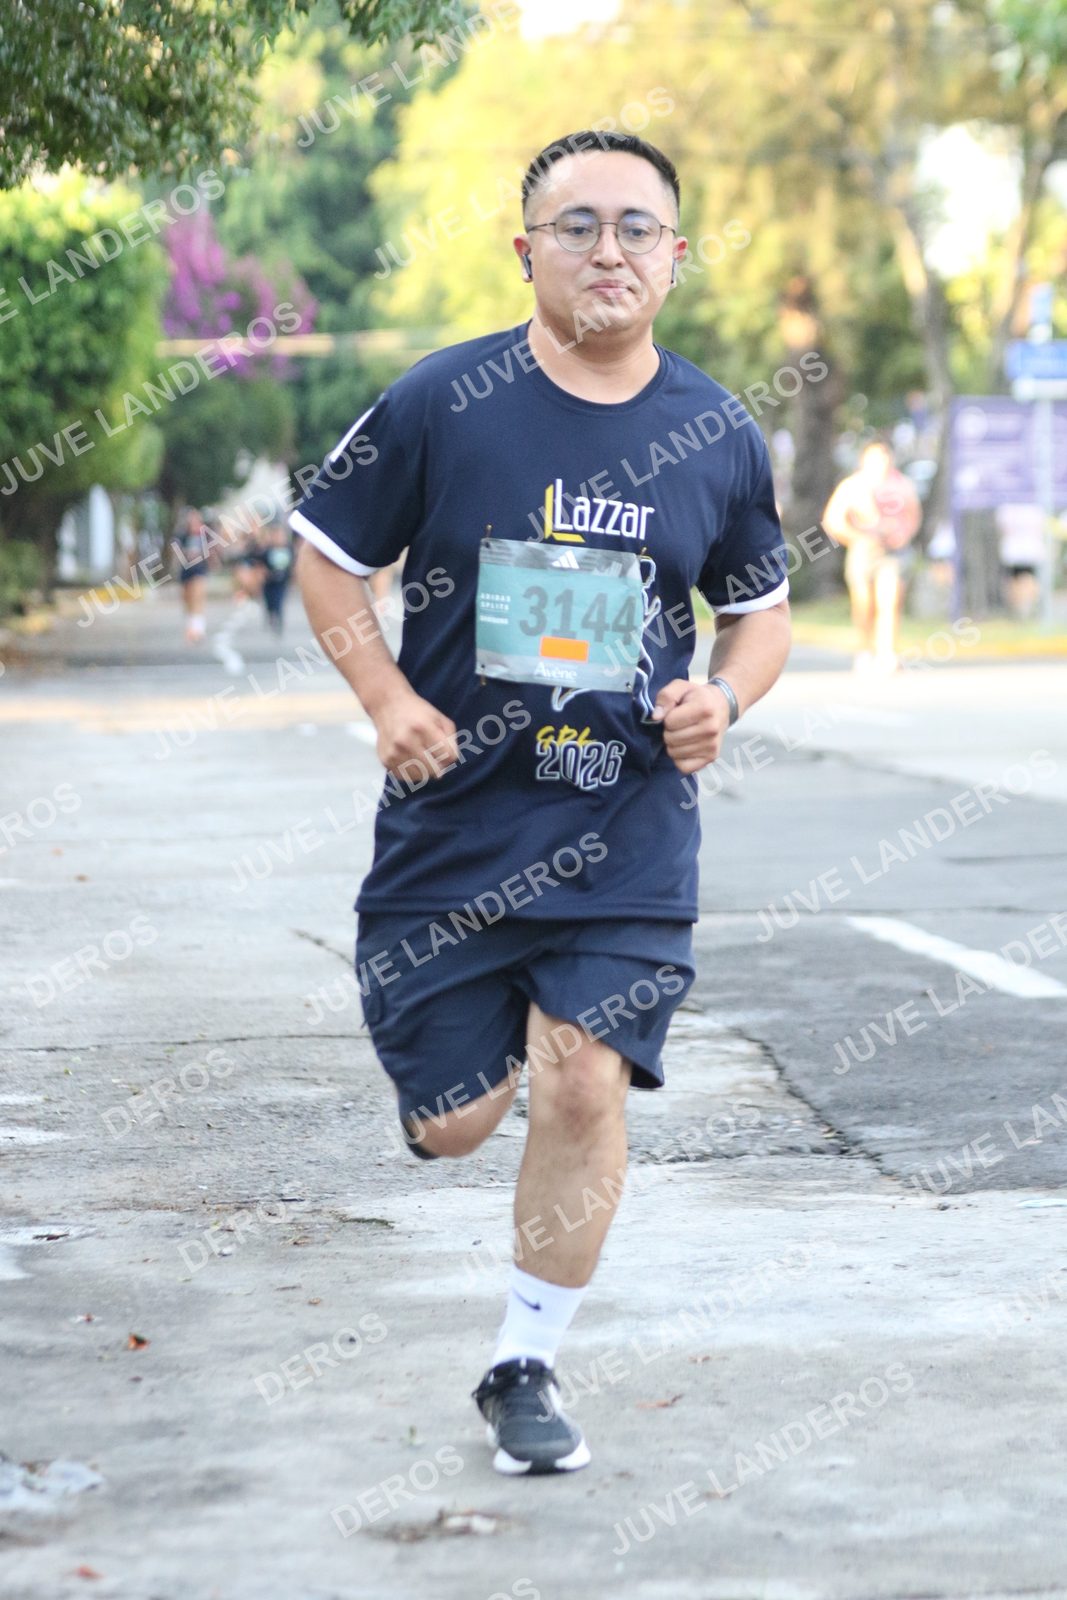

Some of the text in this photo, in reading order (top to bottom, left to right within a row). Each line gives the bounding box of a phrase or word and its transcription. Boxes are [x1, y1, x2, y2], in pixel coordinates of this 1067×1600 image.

[545, 478, 655, 541] Lazzar
[519, 584, 639, 646] 3144
[536, 740, 627, 790] 2026
